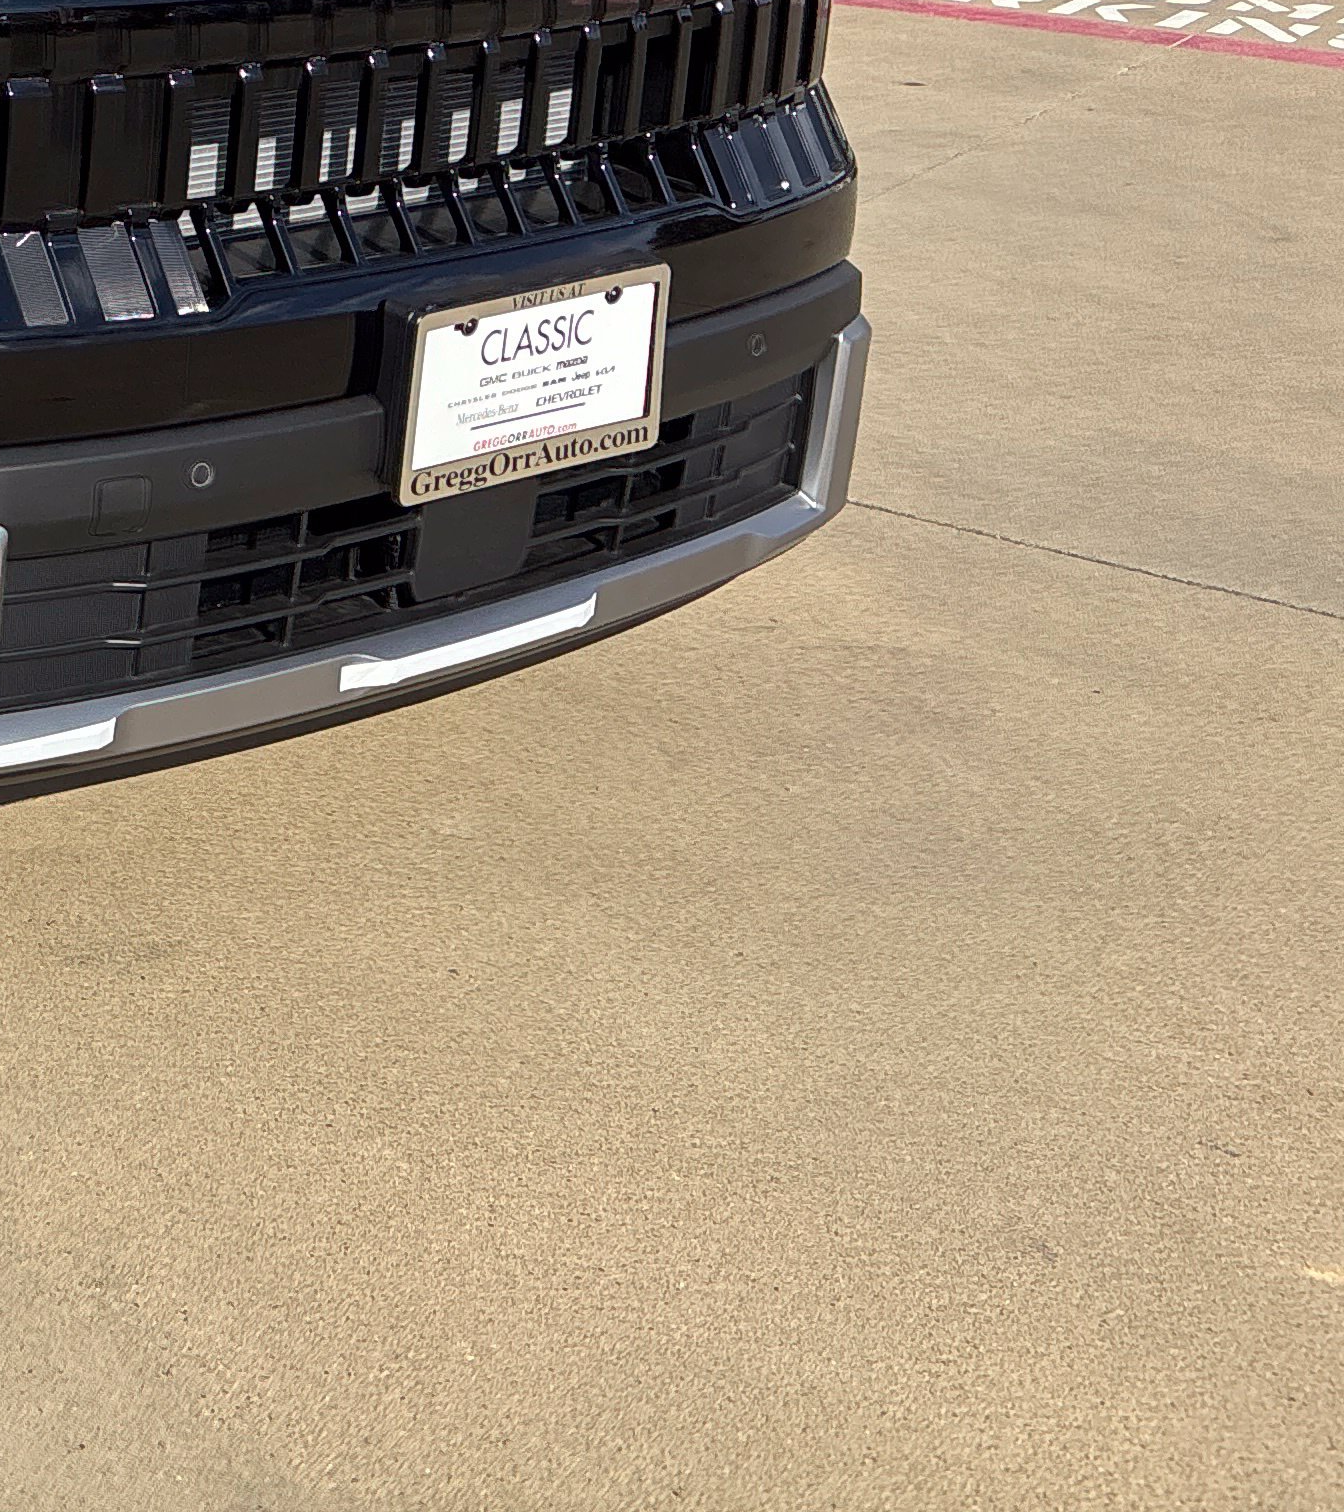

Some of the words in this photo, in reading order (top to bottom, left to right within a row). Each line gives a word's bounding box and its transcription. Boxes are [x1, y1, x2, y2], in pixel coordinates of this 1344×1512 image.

[512, 291, 545, 310] VISIT
[548, 286, 565, 302] US
[566, 282, 587, 298] AT
[480, 309, 595, 366] CLASSIC
[447, 392, 497, 408] CHRYSLER
[571, 371, 591, 382] Jeep
[479, 373, 508, 388] GMC
[512, 364, 551, 380] BUICK
[455, 403, 520, 426] Mercedes-Benz
[536, 384, 603, 408] CHEVROLET
[473, 422, 578, 451] GREGGORRAUTO.com
[411, 425, 649, 496] GreggOrrAuto.com
